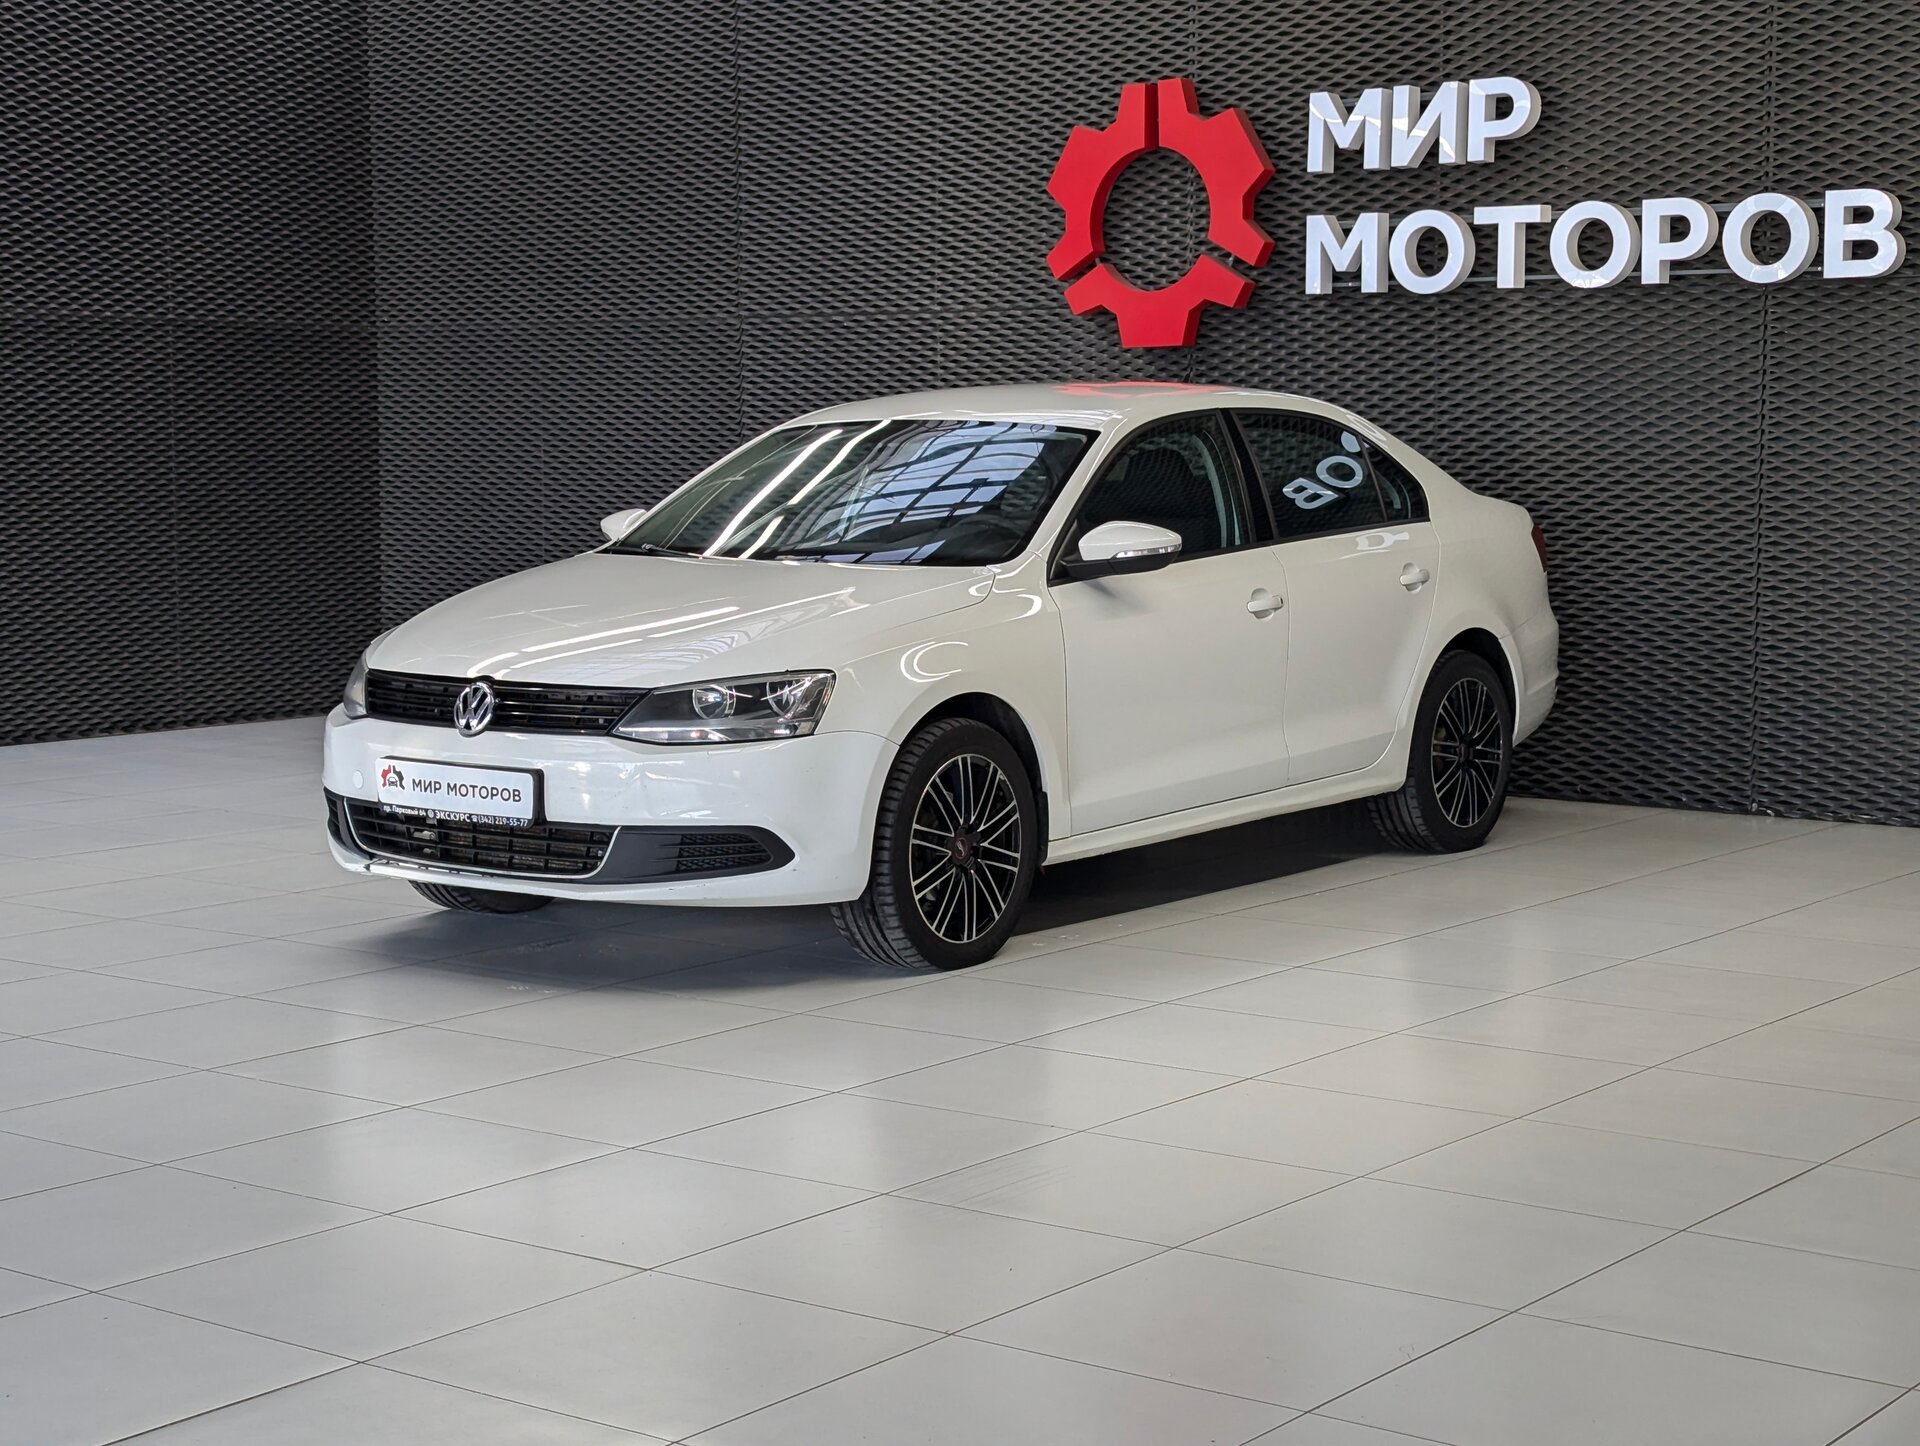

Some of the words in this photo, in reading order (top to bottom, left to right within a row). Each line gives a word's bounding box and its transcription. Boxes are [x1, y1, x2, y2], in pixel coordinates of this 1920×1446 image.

[1307, 76, 1542, 173] МИР
[1305, 188, 1906, 295] МОТОРОВ
[412, 778, 442, 794] МИР
[447, 782, 522, 802] МОТОРОВ
[435, 811, 471, 822] ЭКСКУРС
[477, 815, 495, 825] (342)
